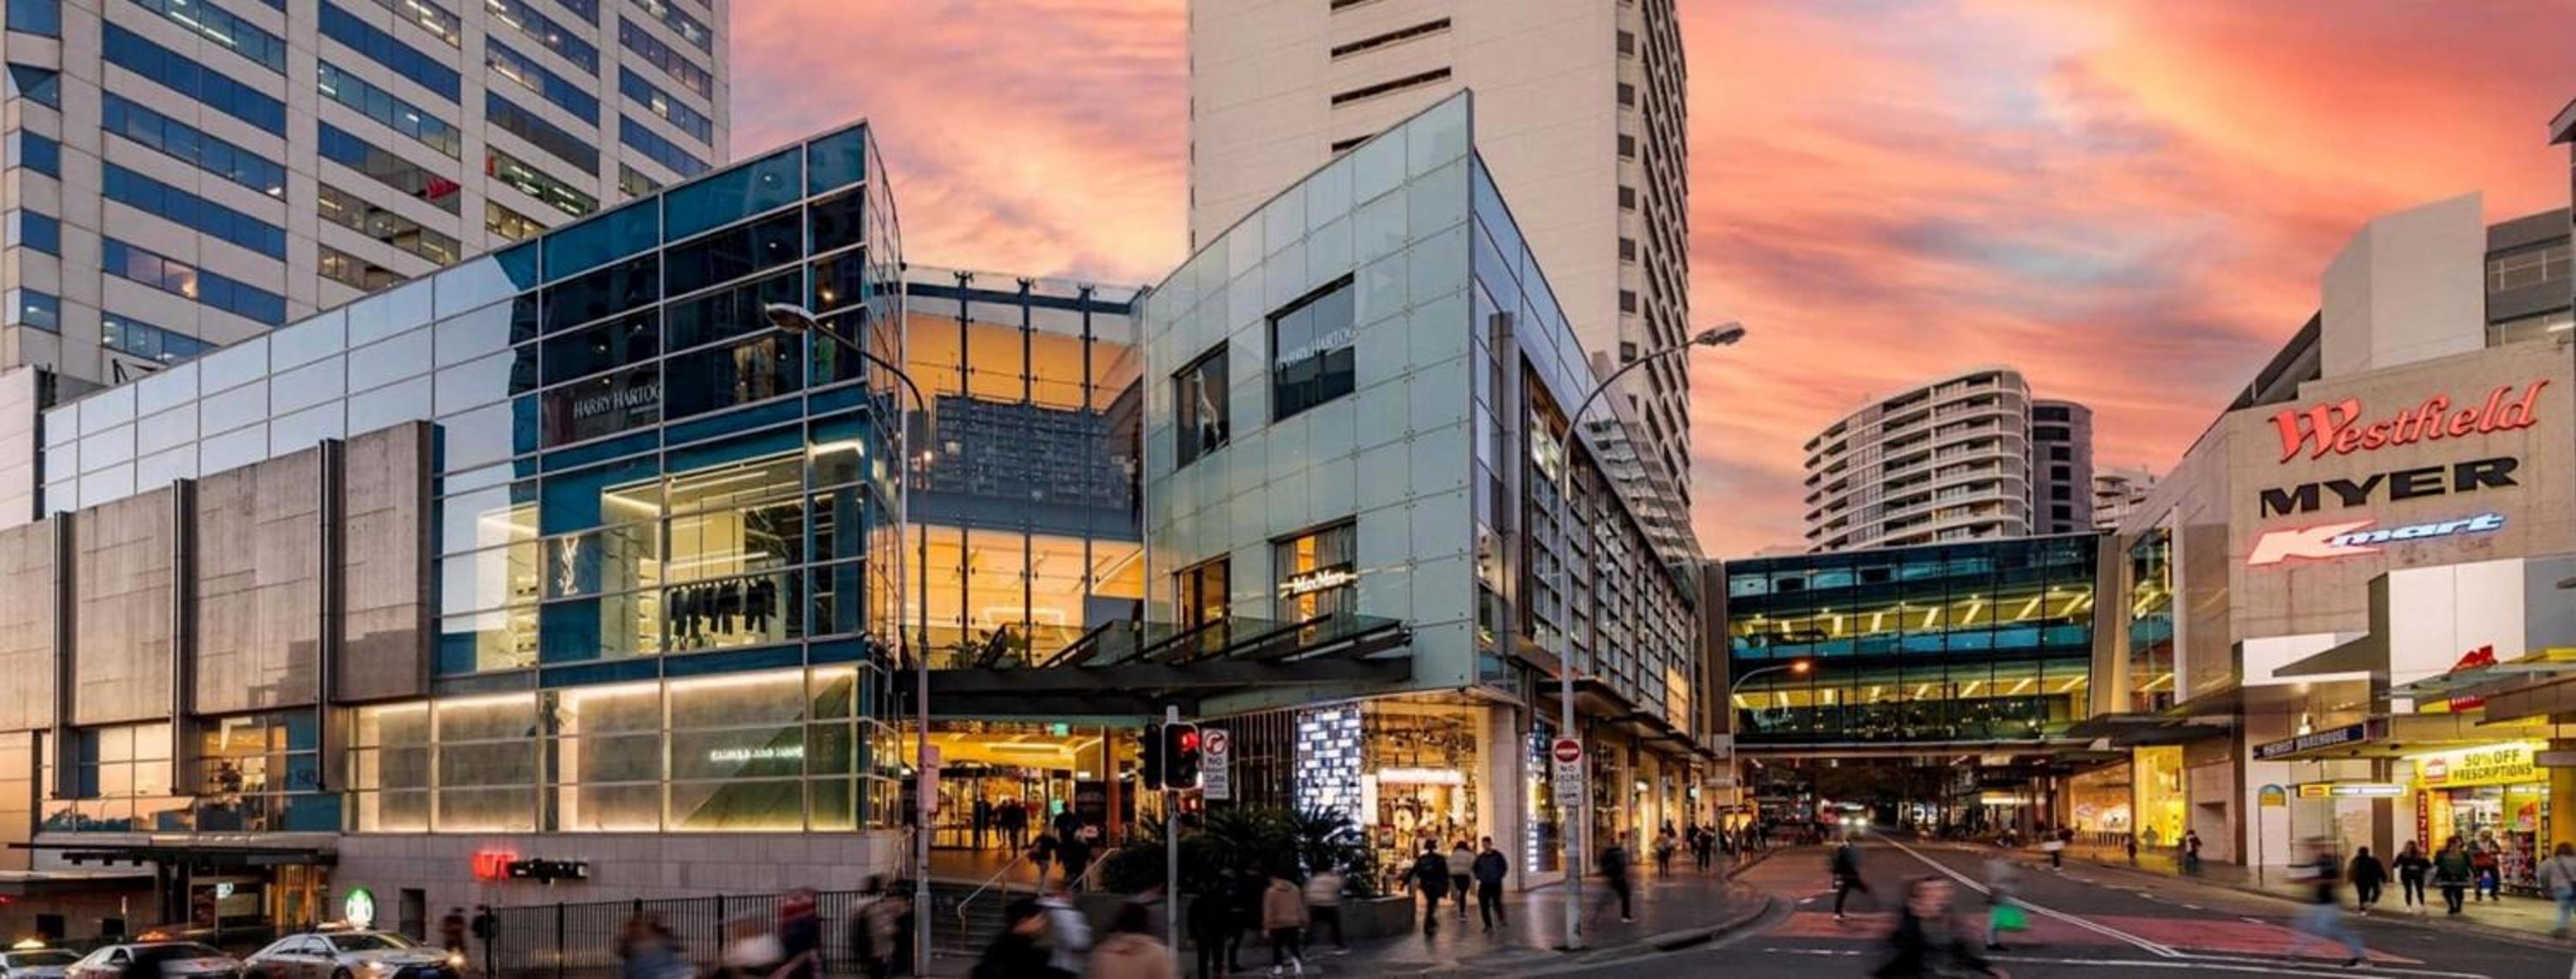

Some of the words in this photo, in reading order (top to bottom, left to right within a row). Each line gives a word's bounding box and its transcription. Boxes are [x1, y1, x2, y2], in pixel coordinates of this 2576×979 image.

[574, 395, 611, 419] HARRY
[2268, 380, 2550, 465] Westfield
[2260, 456, 2519, 519] MYER
[2246, 512, 2506, 566] Kmart
[1208, 757, 1224, 767] NO
[2464, 753, 2492, 767] 50%
[2494, 749, 2520, 763] OFF
[2453, 766, 2532, 781] PRESCRIPTIONS
